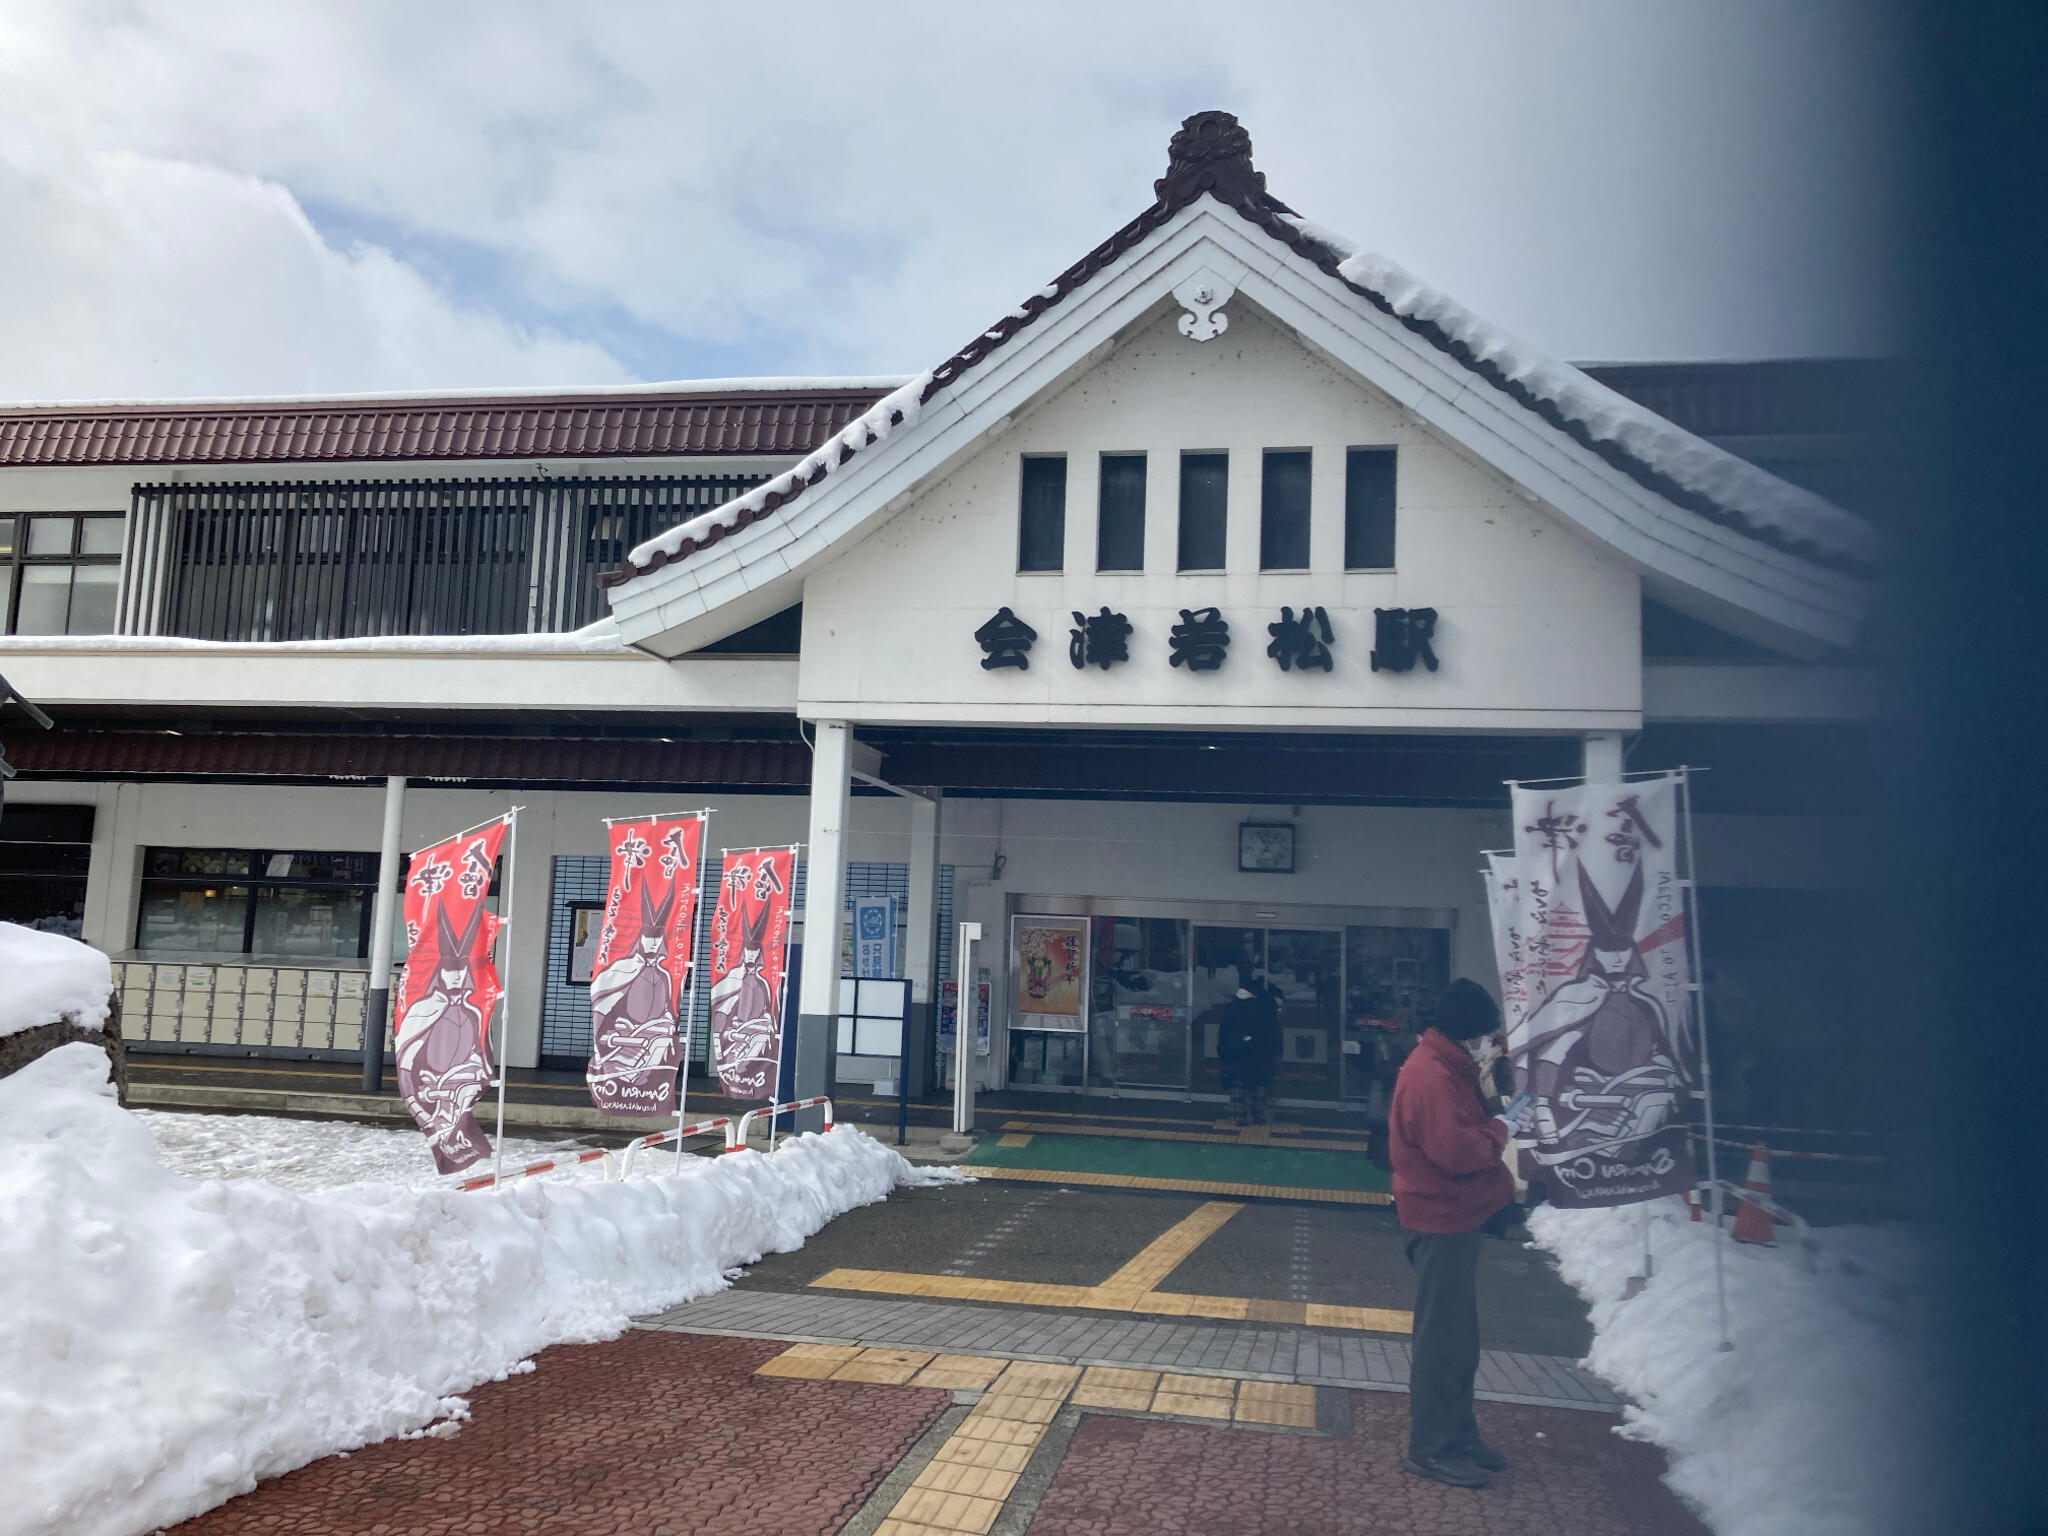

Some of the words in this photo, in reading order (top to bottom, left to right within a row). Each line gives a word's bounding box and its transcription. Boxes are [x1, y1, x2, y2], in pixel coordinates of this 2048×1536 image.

[974, 605, 1439, 673] 会津若松駅
